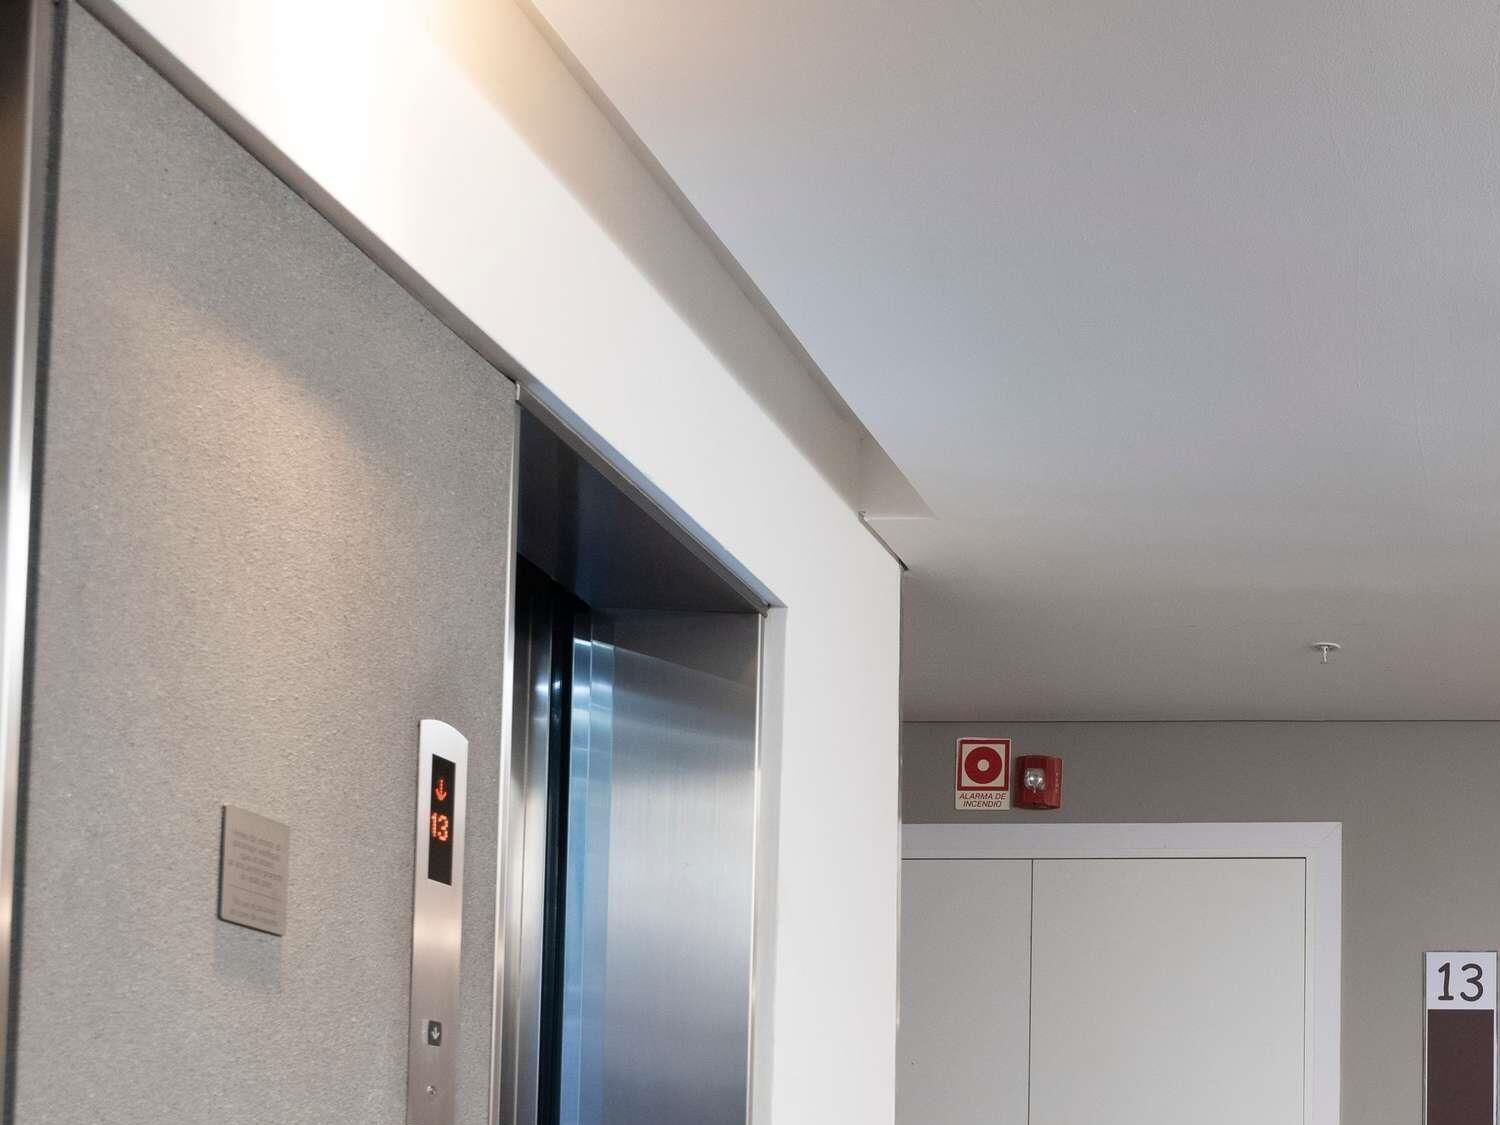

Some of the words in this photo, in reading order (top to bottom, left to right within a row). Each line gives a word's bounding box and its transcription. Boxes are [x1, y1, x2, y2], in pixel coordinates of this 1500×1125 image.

[960, 792, 993, 800] ALARMA
[995, 792, 1007, 800] DE
[963, 800, 1002, 808] INCENDIO
[431, 812, 449, 841] 13
[1438, 962, 1484, 1002] 13
